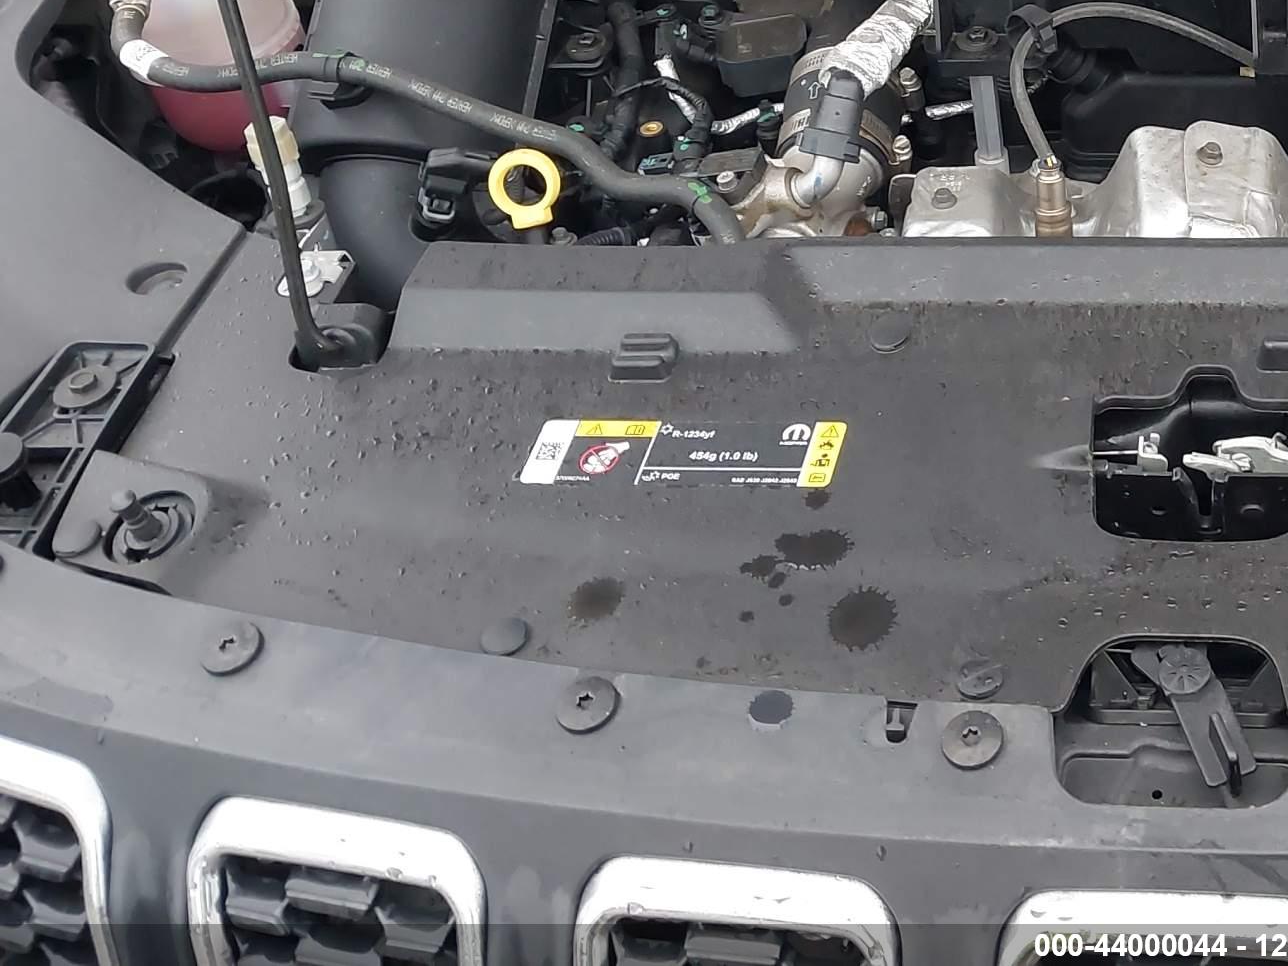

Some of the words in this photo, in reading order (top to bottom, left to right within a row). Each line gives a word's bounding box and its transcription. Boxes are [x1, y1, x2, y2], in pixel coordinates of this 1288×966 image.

[671, 430, 716, 440] R-1234yf
[688, 451, 717, 462] 454g
[718, 451, 741, 462] (1.0
[742, 451, 758, 462] lb)
